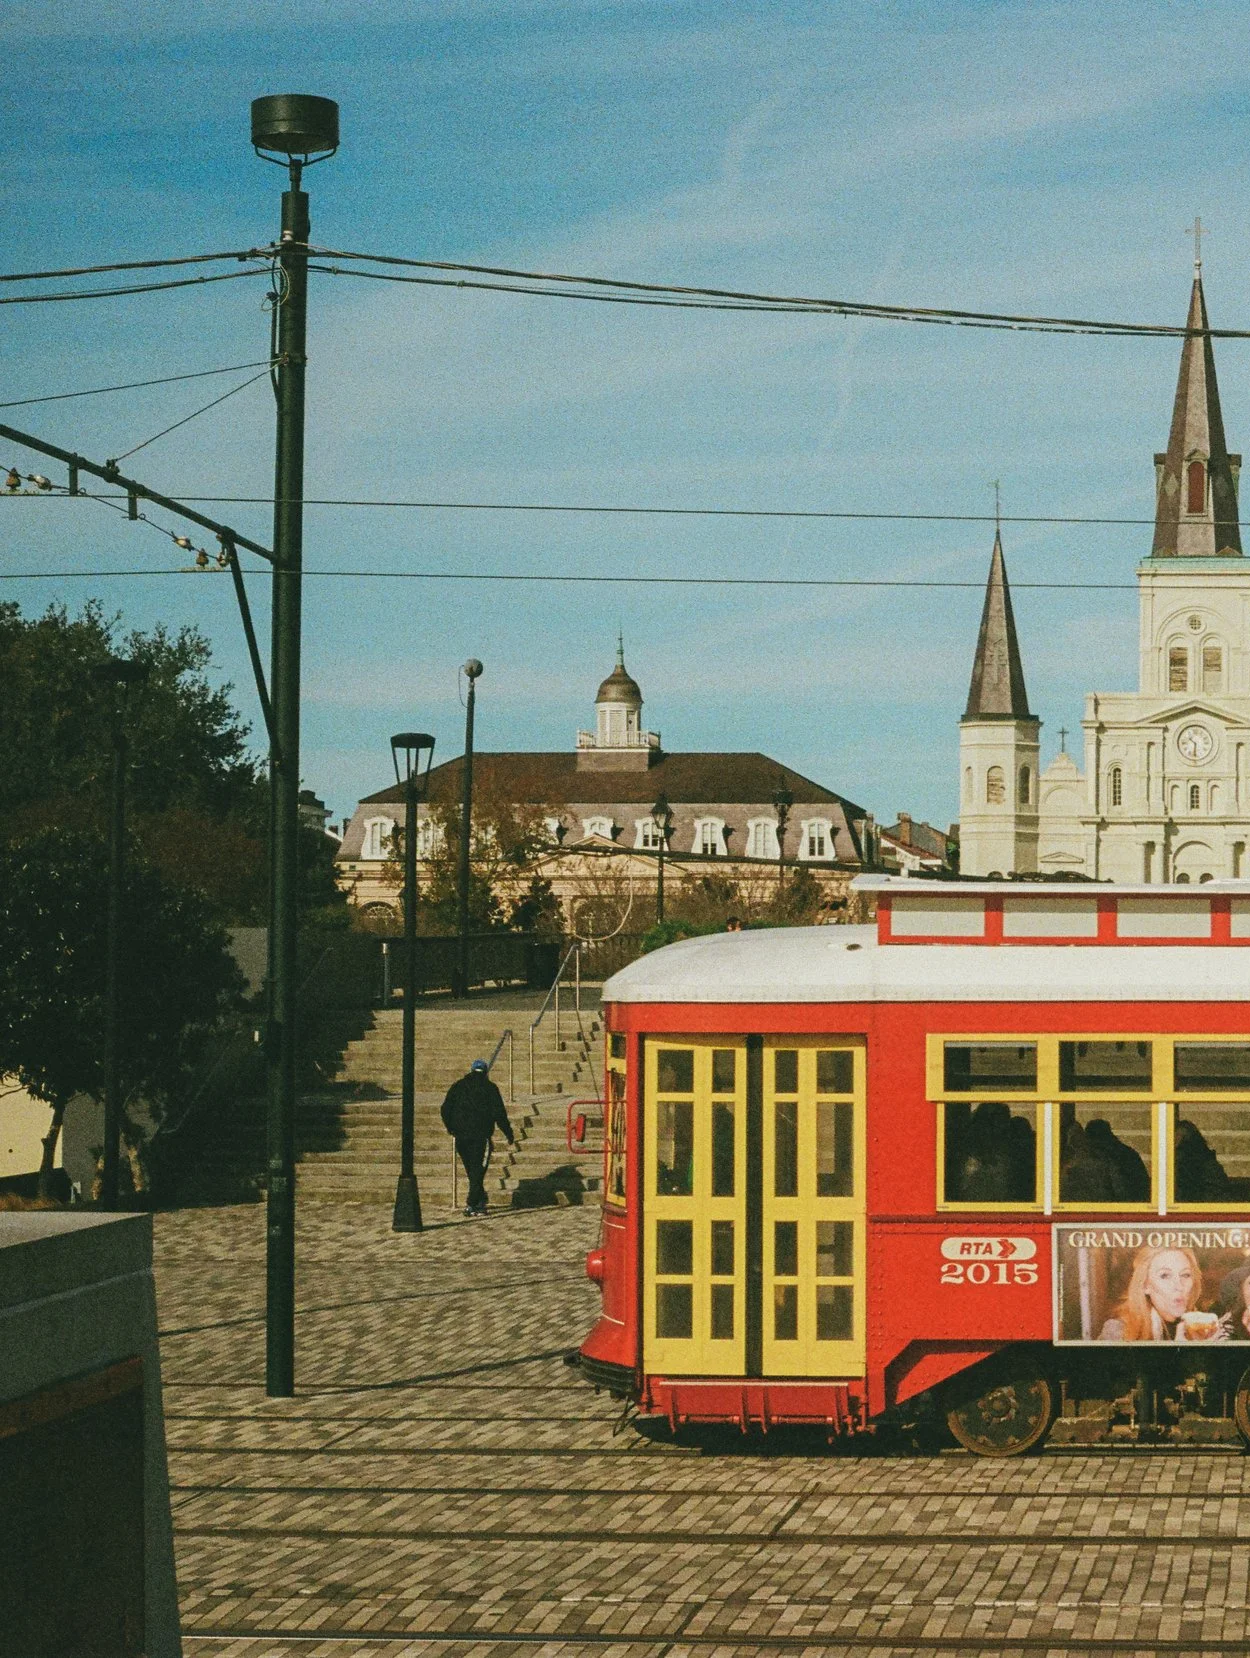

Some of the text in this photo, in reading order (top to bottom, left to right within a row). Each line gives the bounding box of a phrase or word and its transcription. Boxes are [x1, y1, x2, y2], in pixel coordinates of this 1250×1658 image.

[1068, 1231, 1142, 1248] GRAND
[1147, 1231, 1250, 1248] OPENING!
[960, 1242, 993, 1255] RTA
[940, 1262, 1038, 1285] 2015
